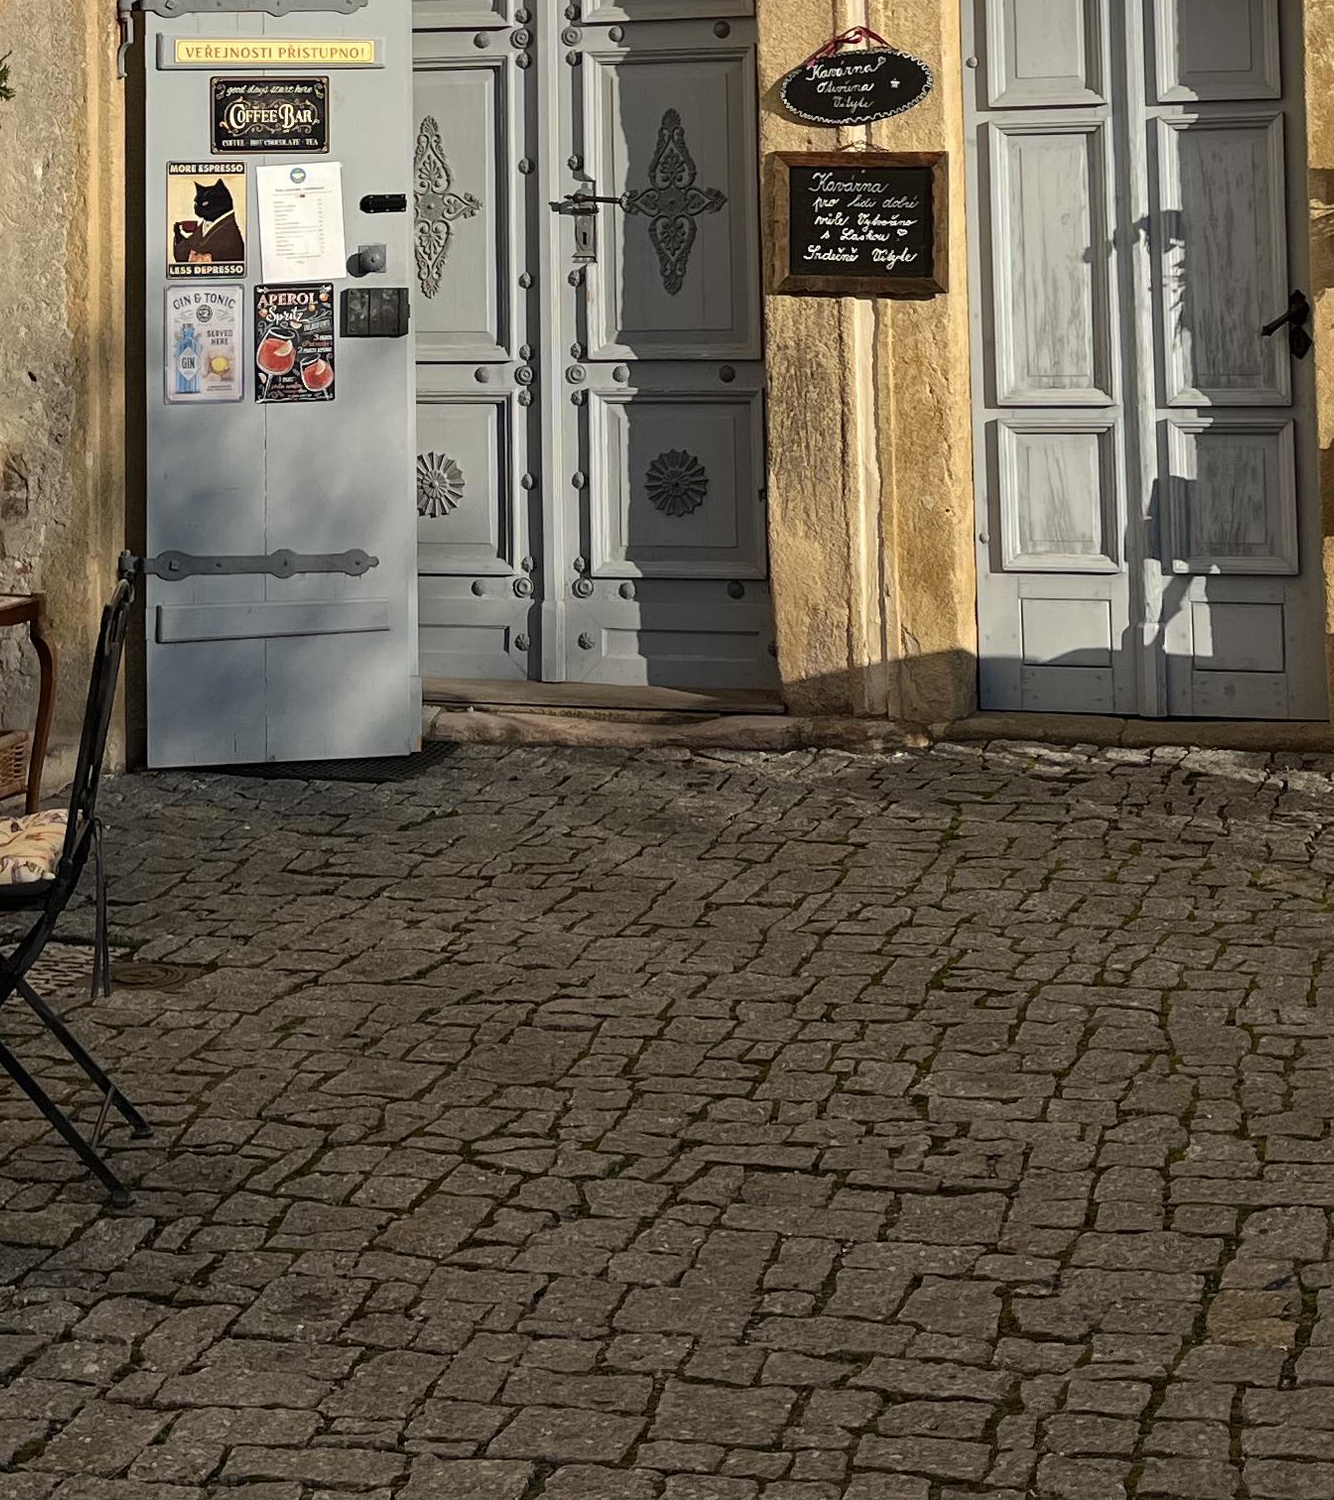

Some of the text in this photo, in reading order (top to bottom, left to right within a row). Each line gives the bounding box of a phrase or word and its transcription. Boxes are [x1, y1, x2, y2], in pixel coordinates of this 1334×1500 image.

[185, 44, 365, 59] VEŘEJNOSTI PŘÍSTUPNO!
[806, 61, 880, 80] Kavárna
[226, 84, 313, 96] good days start here
[229, 104, 313, 129] COFFEE BAR
[170, 163, 243, 173] MORE ESPRESSO
[808, 172, 889, 193] Kavárna
[813, 196, 839, 212] pro
[820, 230, 831, 240] s
[169, 264, 243, 274] LESS DEPRESSO
[173, 292, 236, 310] GIN & TONIC
[257, 292, 317, 309] APEROL
[266, 305, 308, 325] Spritz
[207, 330, 233, 338] SERVED
[181, 357, 195, 369] GIN
